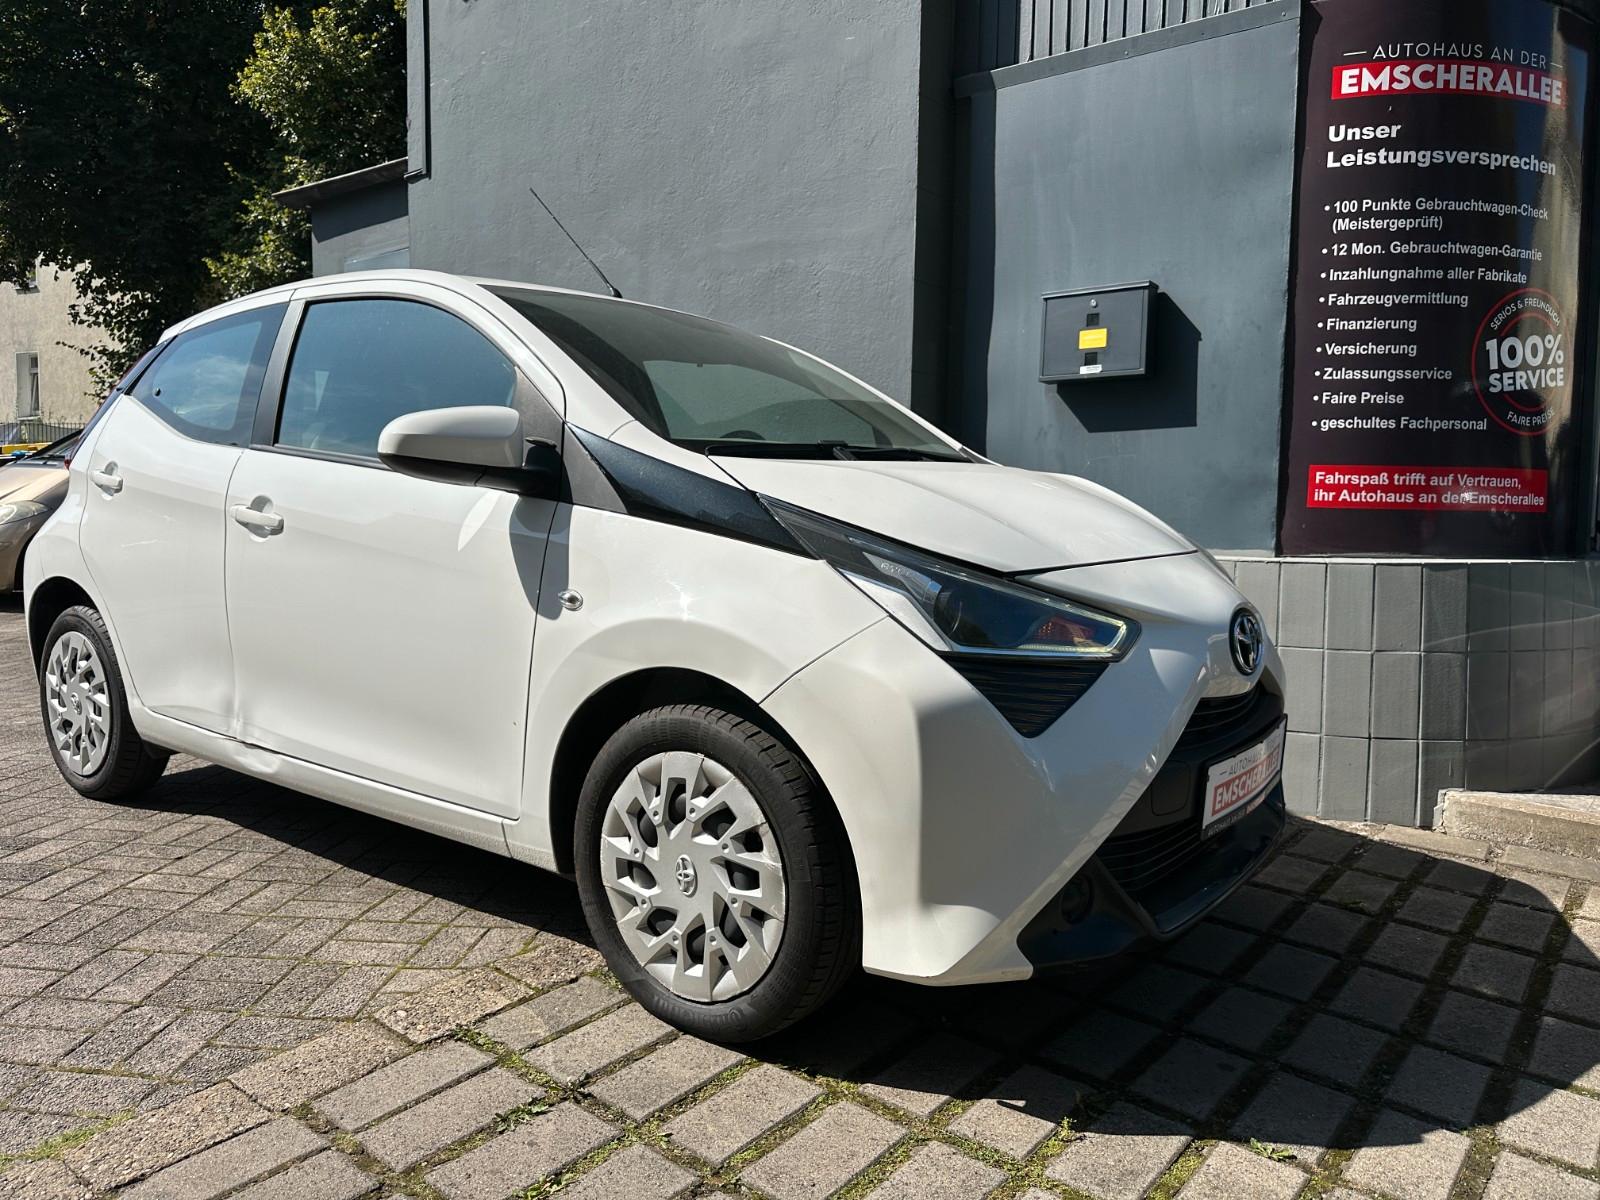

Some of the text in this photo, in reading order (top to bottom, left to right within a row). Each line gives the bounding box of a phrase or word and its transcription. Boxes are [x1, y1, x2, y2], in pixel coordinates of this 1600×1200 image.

[1372, 42, 1547, 69] AUTOHAUS AN DER
[1340, 63, 1563, 105] EMSCHERALLEE
[1328, 123, 1402, 143] Unser
[1326, 147, 1556, 176] Leistungsversprechen
[1333, 197, 1548, 220] 100 Punkte Gebrauchtwagen-Check
[1332, 215, 1443, 234] (Meistergeprüft)
[1331, 241, 1542, 261] 12 Mon. Gebrauchtwagen-Garantie
[1329, 267, 1527, 284] Inzahlungnahme aller Fabrikate
[1328, 292, 1469, 307] Fahrzeugvermittlung
[1524, 297, 1561, 327] FREUNDLICH
[1326, 318, 1417, 332] Finanzierung
[1325, 343, 1417, 357] Versicherung
[1485, 333, 1564, 370] 100%
[1323, 367, 1453, 381] Zulassungsservice
[1488, 367, 1565, 393] SERVICE
[1322, 392, 1405, 405] Faire Preise
[1320, 416, 1487, 432] geschultes Fachpersonal
[1507, 406, 1555, 426] FAIRE PREISE
[1315, 472, 1522, 489] Fahrspaß trifft auf Vertrauen,
[1314, 489, 1545, 506] ihr Autohaus an der Emscherallee
